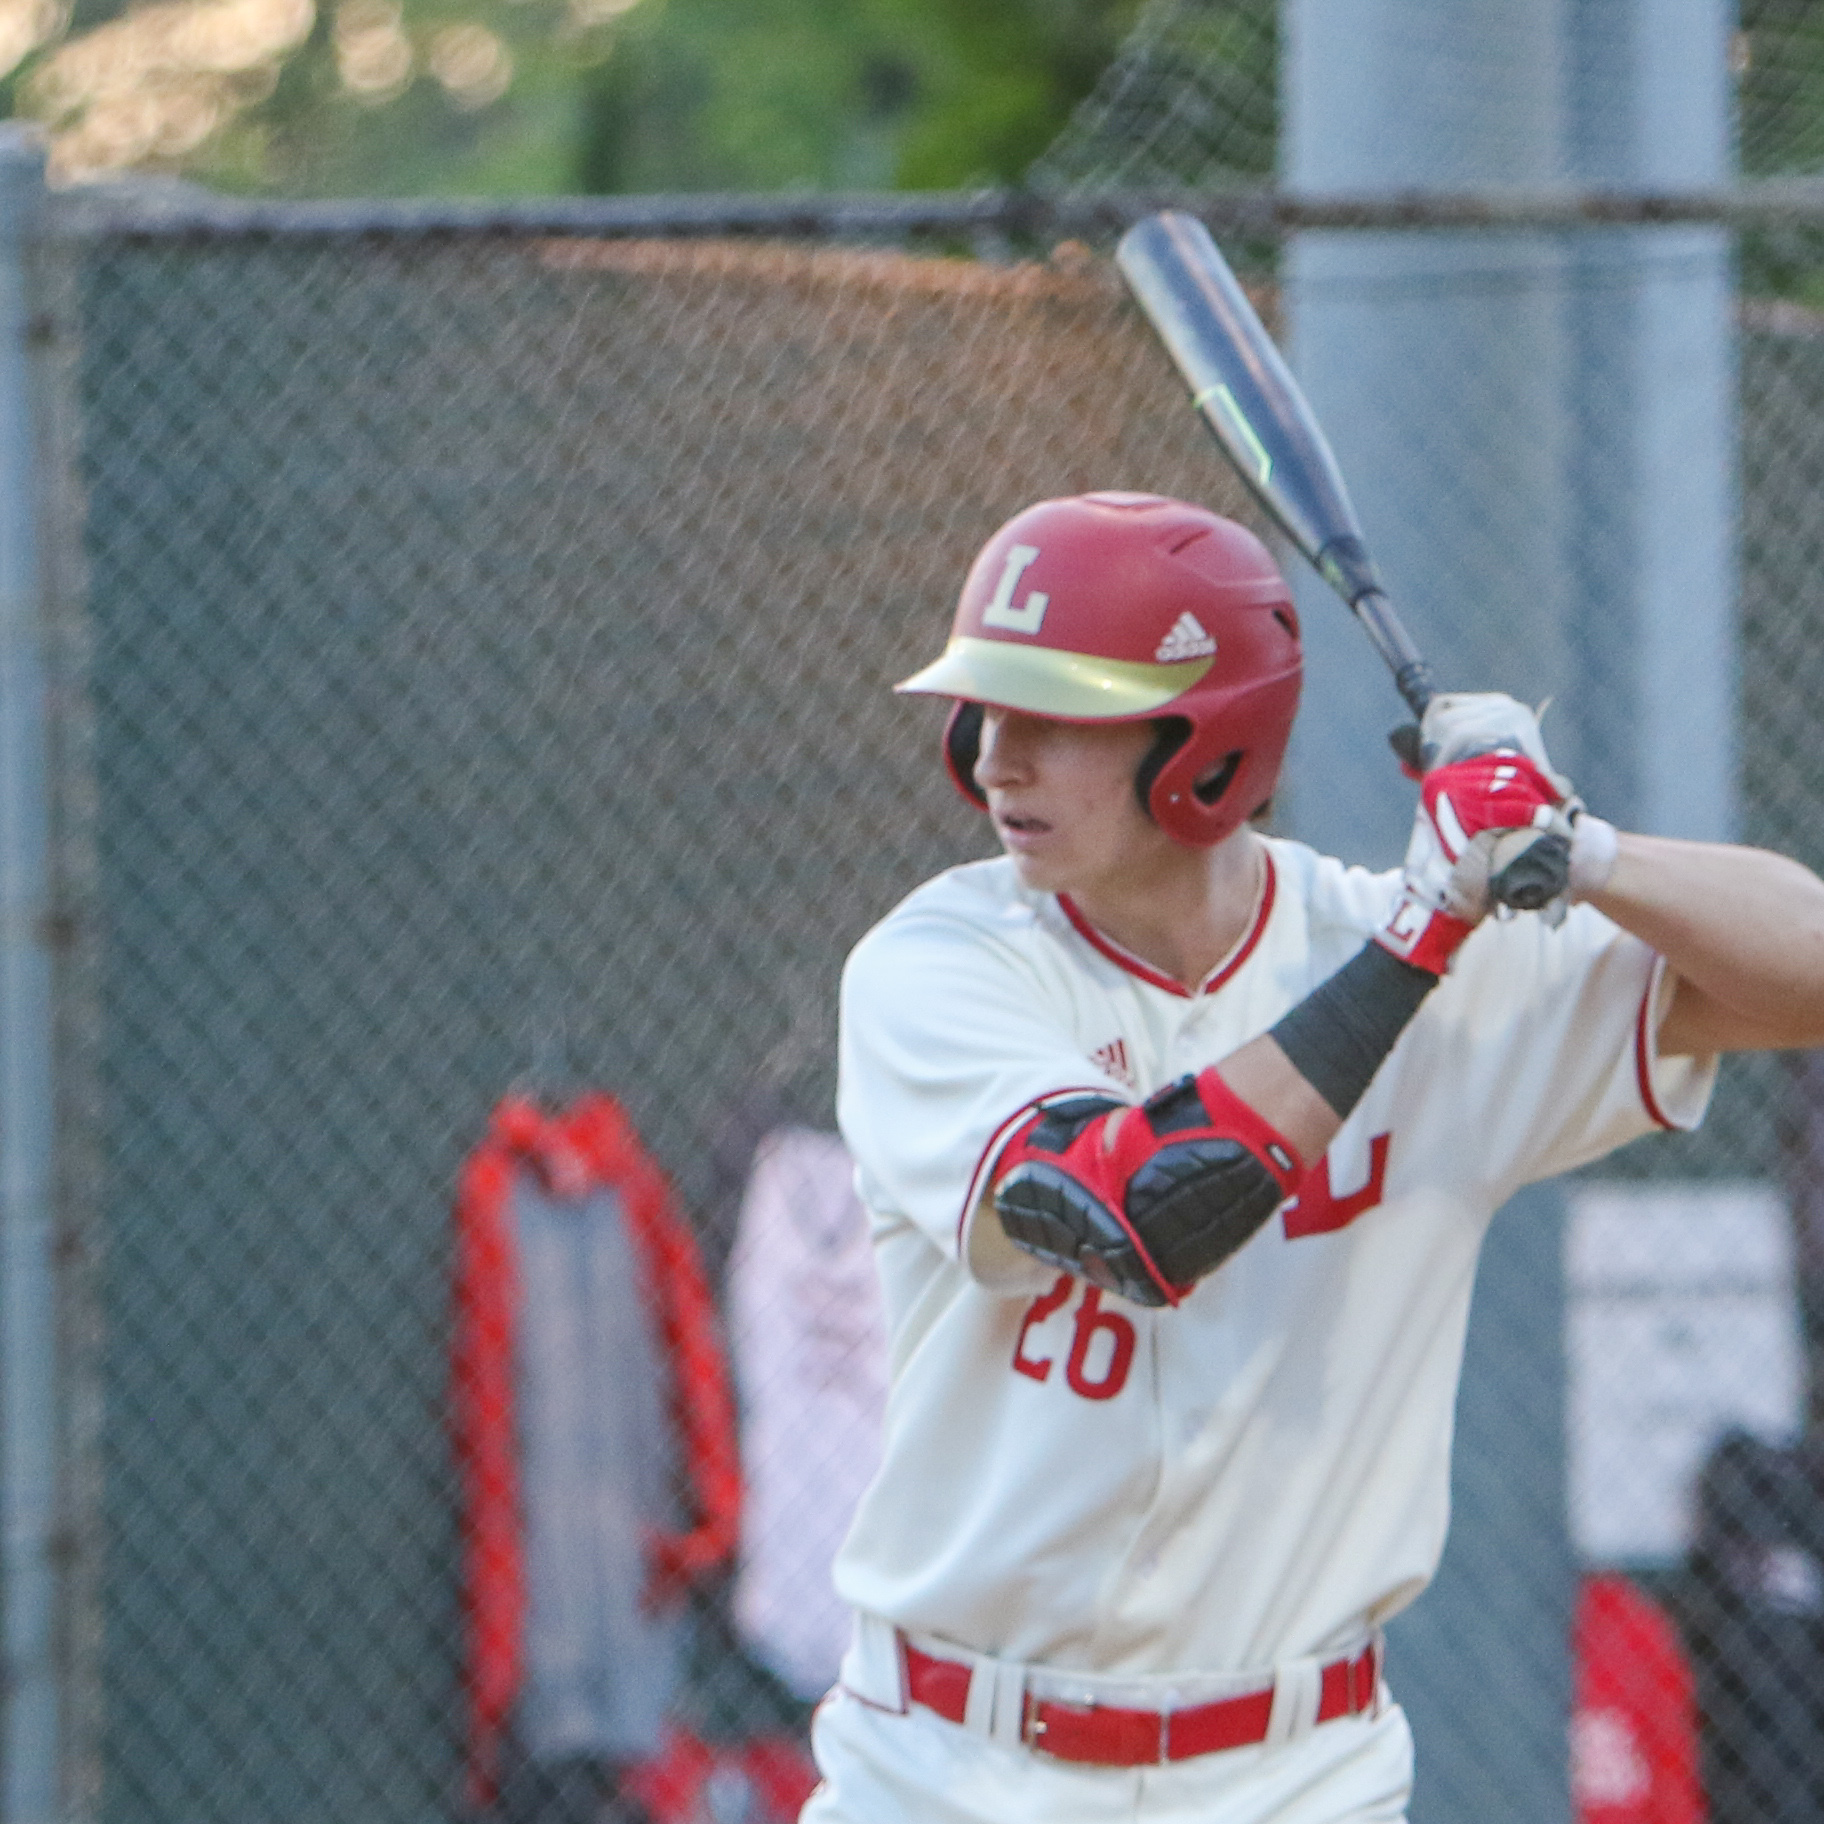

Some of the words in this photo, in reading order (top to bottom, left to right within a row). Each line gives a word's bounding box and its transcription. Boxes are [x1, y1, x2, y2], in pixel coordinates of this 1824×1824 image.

[982, 544, 1051, 636] L
[1386, 899, 1414, 943] L
[1013, 1273, 1136, 1400] 26
